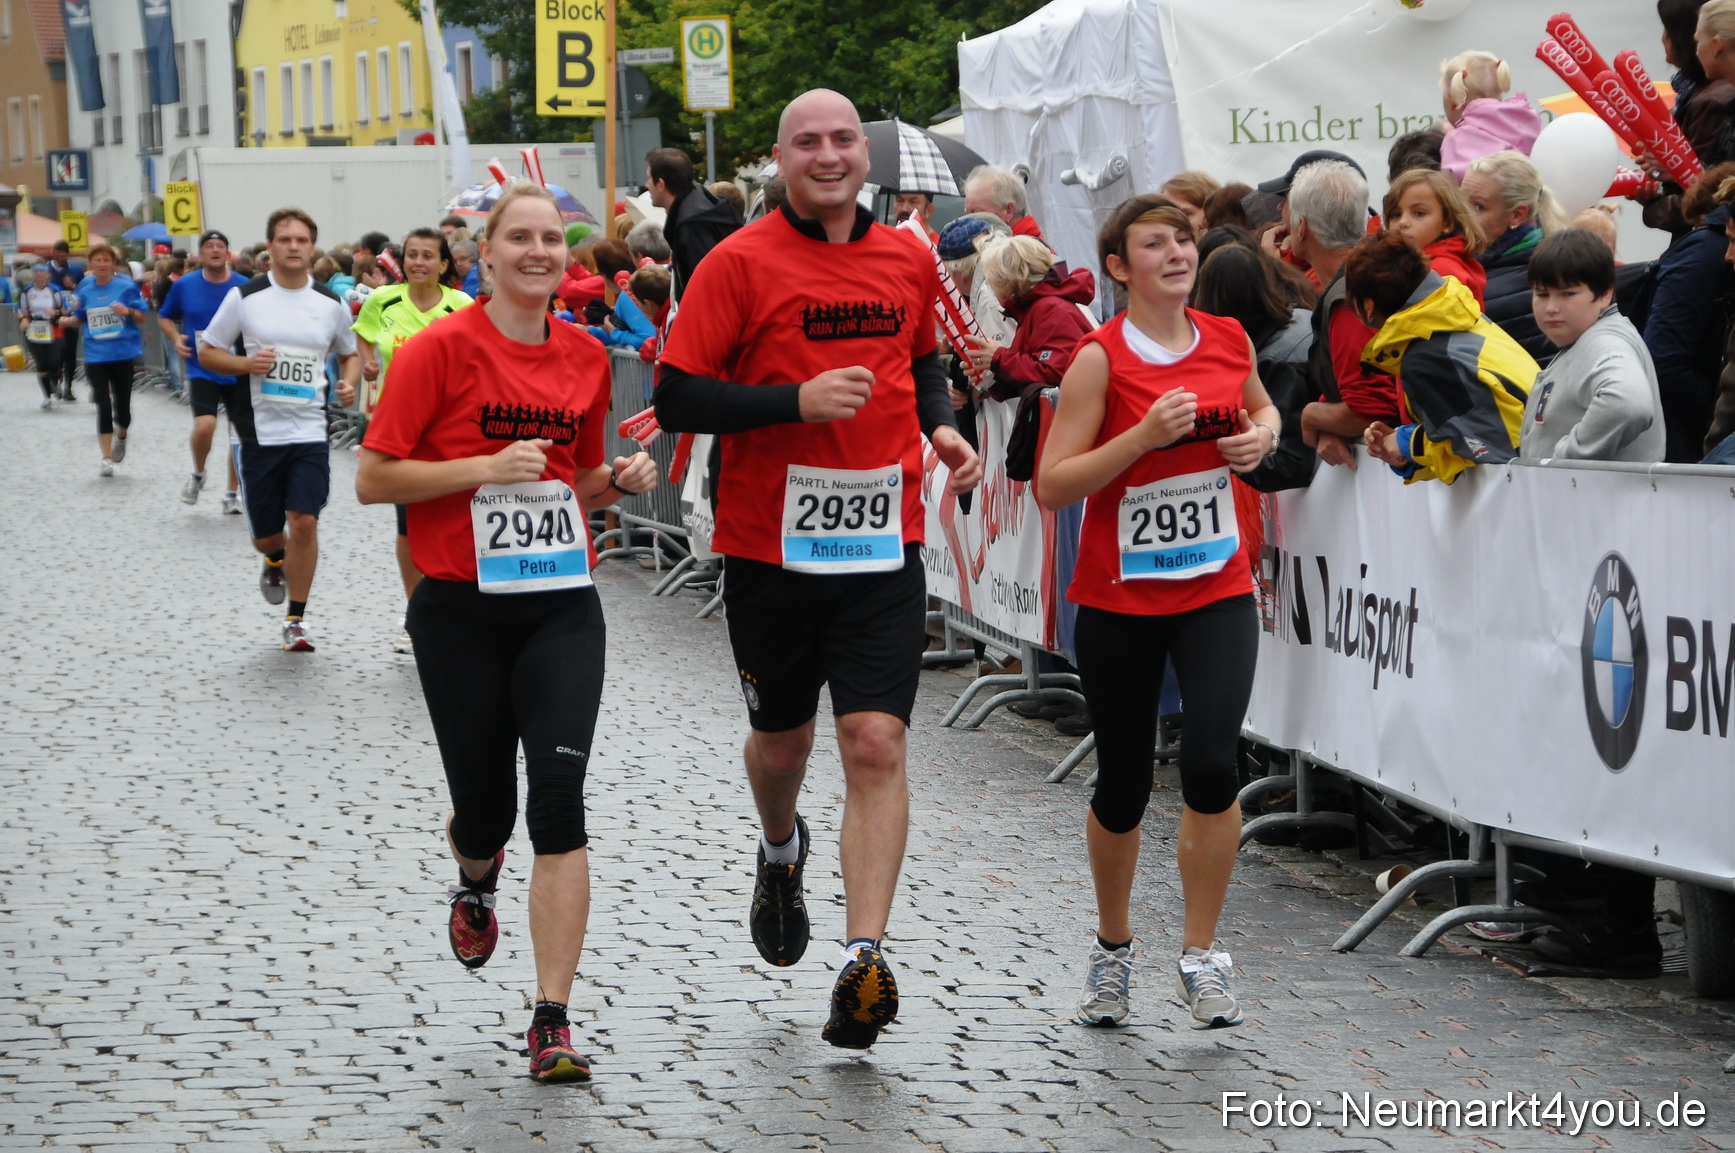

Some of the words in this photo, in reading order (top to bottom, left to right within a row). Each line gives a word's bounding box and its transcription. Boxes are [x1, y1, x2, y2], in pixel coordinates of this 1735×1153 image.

[546, 0, 606, 20] Block
[284, 25, 309, 52] HOTEL
[557, 30, 595, 88] B
[1228, 104, 1363, 144] Kinder
[1645, 130, 1684, 170] BKK
[166, 184, 195, 194] Block
[172, 197, 191, 223] C
[68, 223, 82, 242] D
[809, 321, 834, 335] RUN
[836, 317, 858, 335] FOR
[860, 316, 896, 332] BÜRNI
[265, 361, 313, 383] 2065
[278, 385, 299, 396] Peter
[486, 420, 514, 435] RUN
[516, 421, 540, 437] FOR
[541, 422, 573, 440] BÜRNI
[789, 475, 829, 489] PARTL
[831, 478, 884, 490] Neumarkt
[473, 494, 512, 505] PARTL
[1121, 491, 1158, 506] PARTL
[1160, 482, 1213, 498] Neumarkt
[795, 492, 890, 531] 2939
[1131, 495, 1221, 546] 2931
[486, 507, 575, 550] 2940
[810, 542, 873, 557] Andreas
[1154, 551, 1207, 568] Nadine
[519, 559, 556, 575] Petra
[1588, 559, 1641, 631] BMW
[1665, 615, 1735, 739] BM
[556, 745, 586, 758] CRAFT
